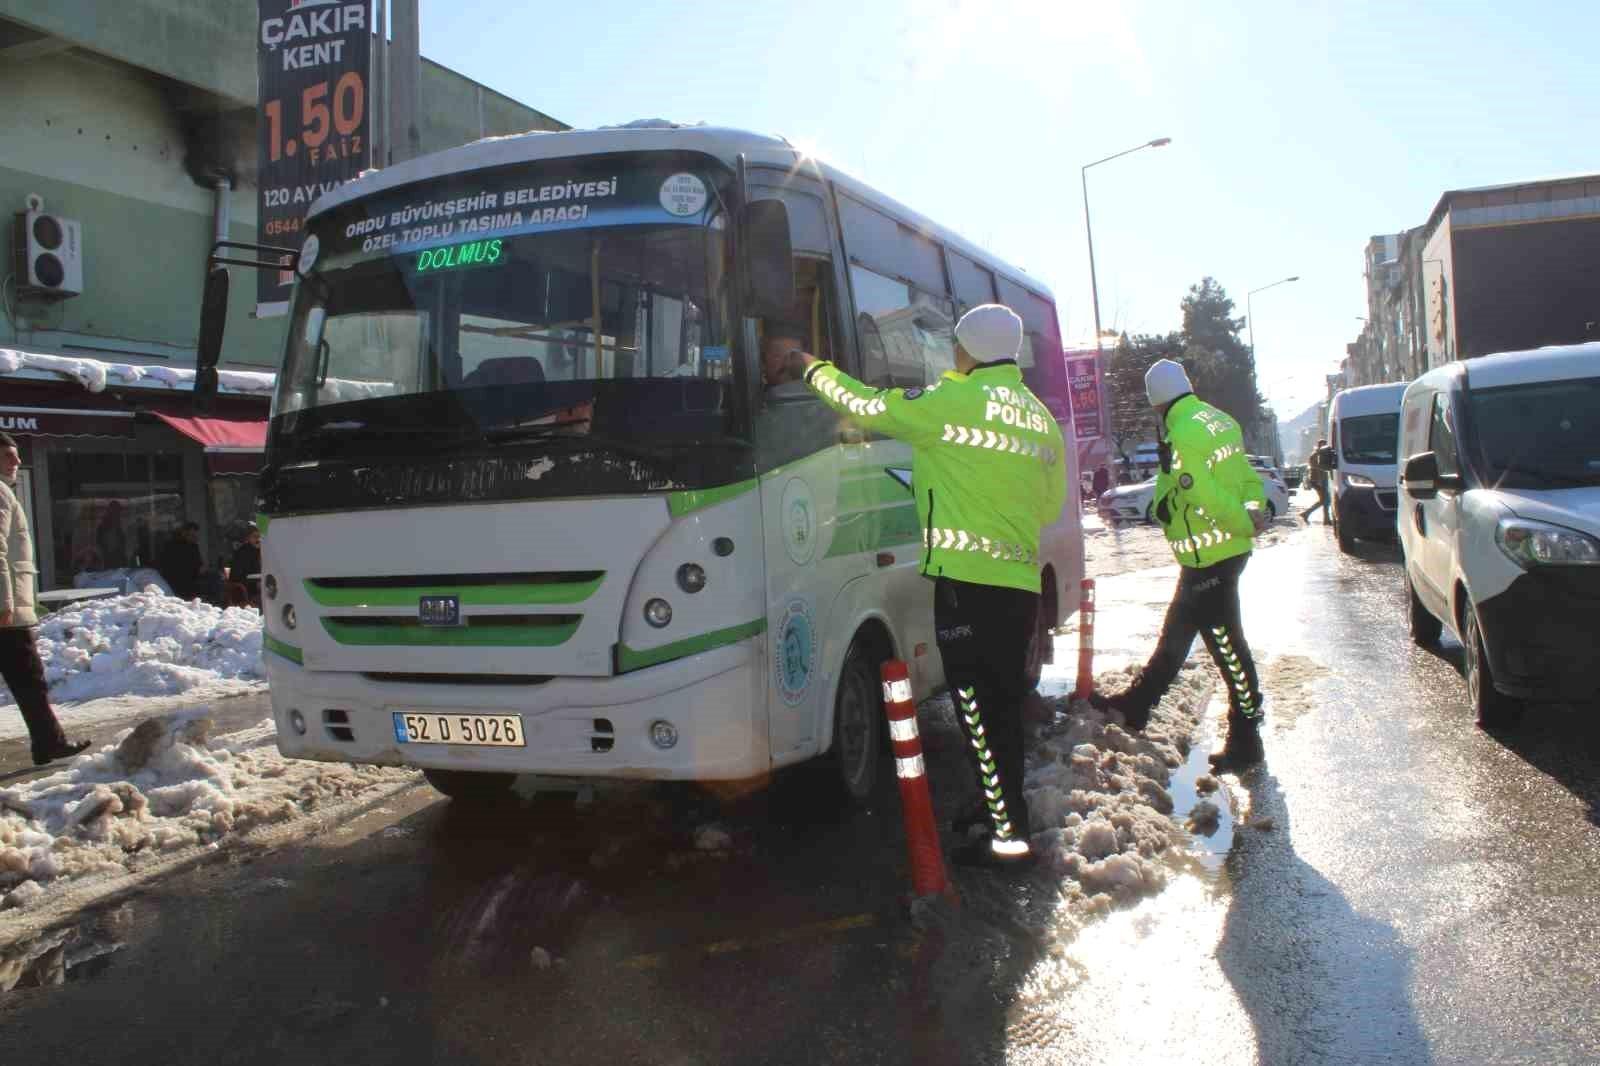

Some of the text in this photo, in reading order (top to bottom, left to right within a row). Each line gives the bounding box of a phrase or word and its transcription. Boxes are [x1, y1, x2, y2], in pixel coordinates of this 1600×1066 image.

[262, 4, 365, 49] ÇAKIR
[283, 40, 345, 71] KENT
[265, 71, 365, 162] 1.50
[264, 187, 290, 208] 120
[294, 183, 317, 204] AY
[345, 176, 617, 238] ORDU BÜYÜKŞEHİR BELEDİYESİ
[362, 233, 399, 253] ÖZEL
[402, 222, 454, 244] TOPLU
[529, 204, 588, 225] ARACI
[416, 239, 503, 272] DOLMUŞ
[406, 716, 517, 743] 52 D 5026
